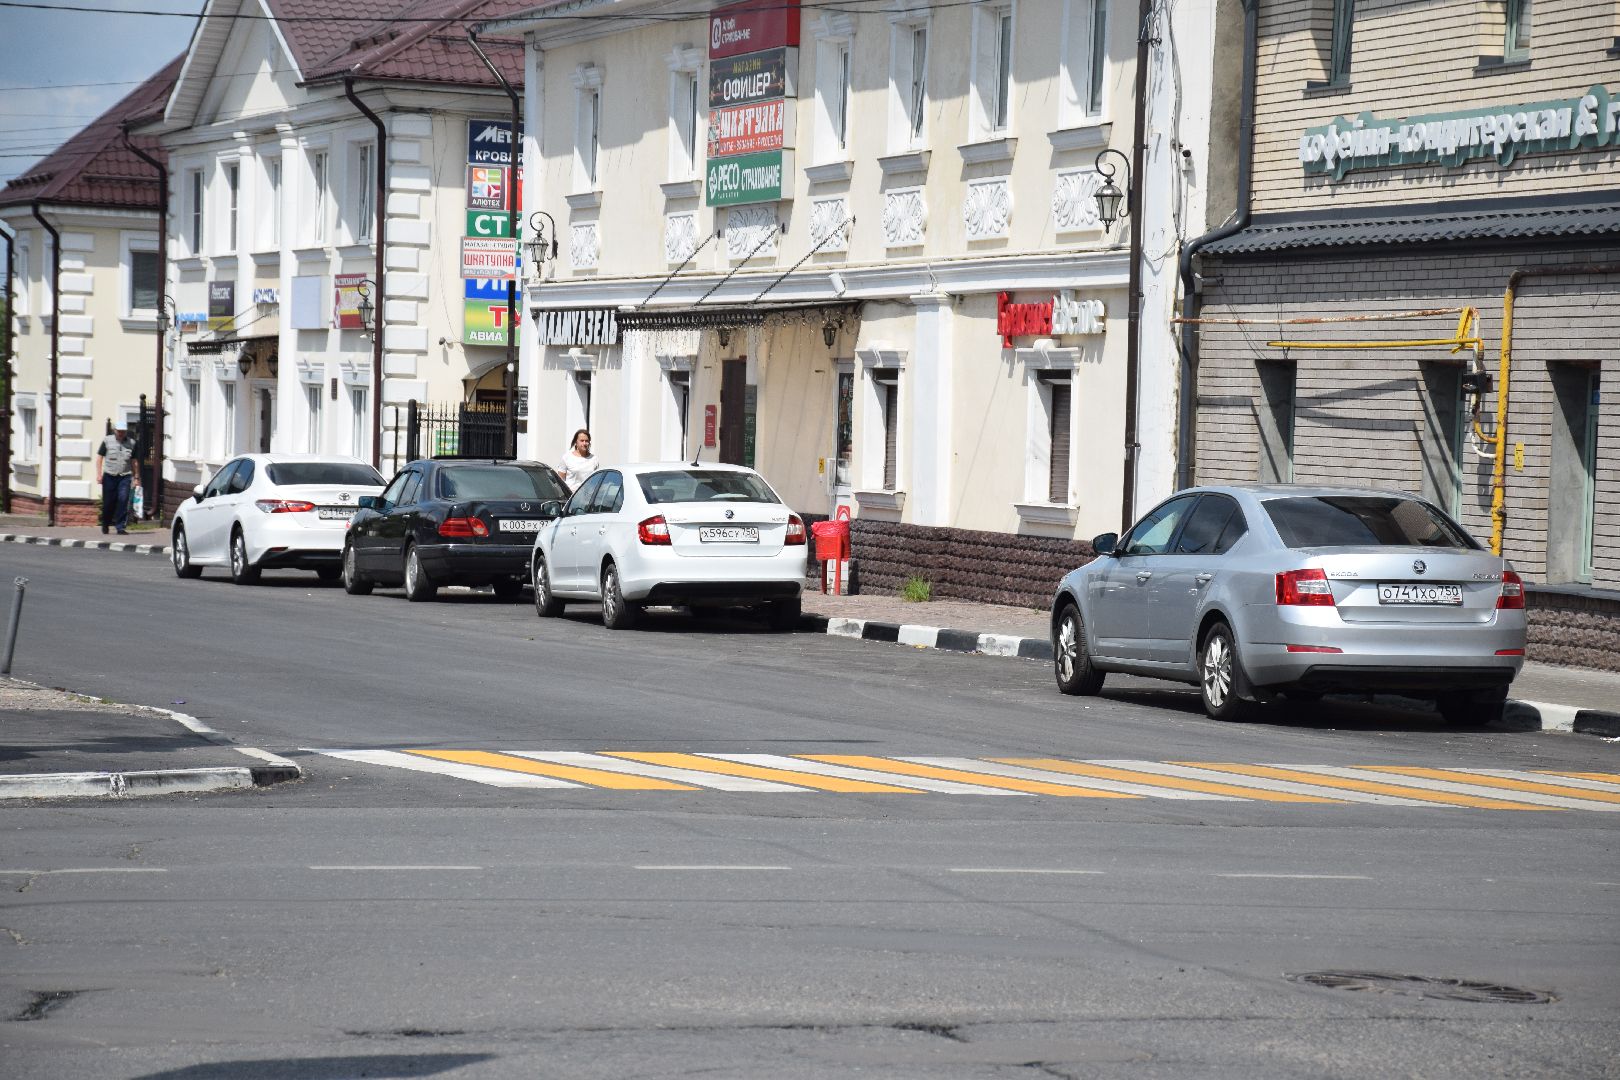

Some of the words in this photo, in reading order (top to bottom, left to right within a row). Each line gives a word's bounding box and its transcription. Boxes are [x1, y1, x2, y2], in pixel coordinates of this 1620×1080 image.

[723, 72, 771, 101] ОФИЦЕР
[720, 103, 784, 138] ШКАТУЛКА
[717, 162, 740, 191] РЕСО
[741, 164, 781, 191] СТРАХОВАНИЕ
[472, 198, 501, 207] АЛЮТЕХ
[464, 253, 515, 267] ШКАТУЛКА
[470, 331, 503, 341] АВИА
